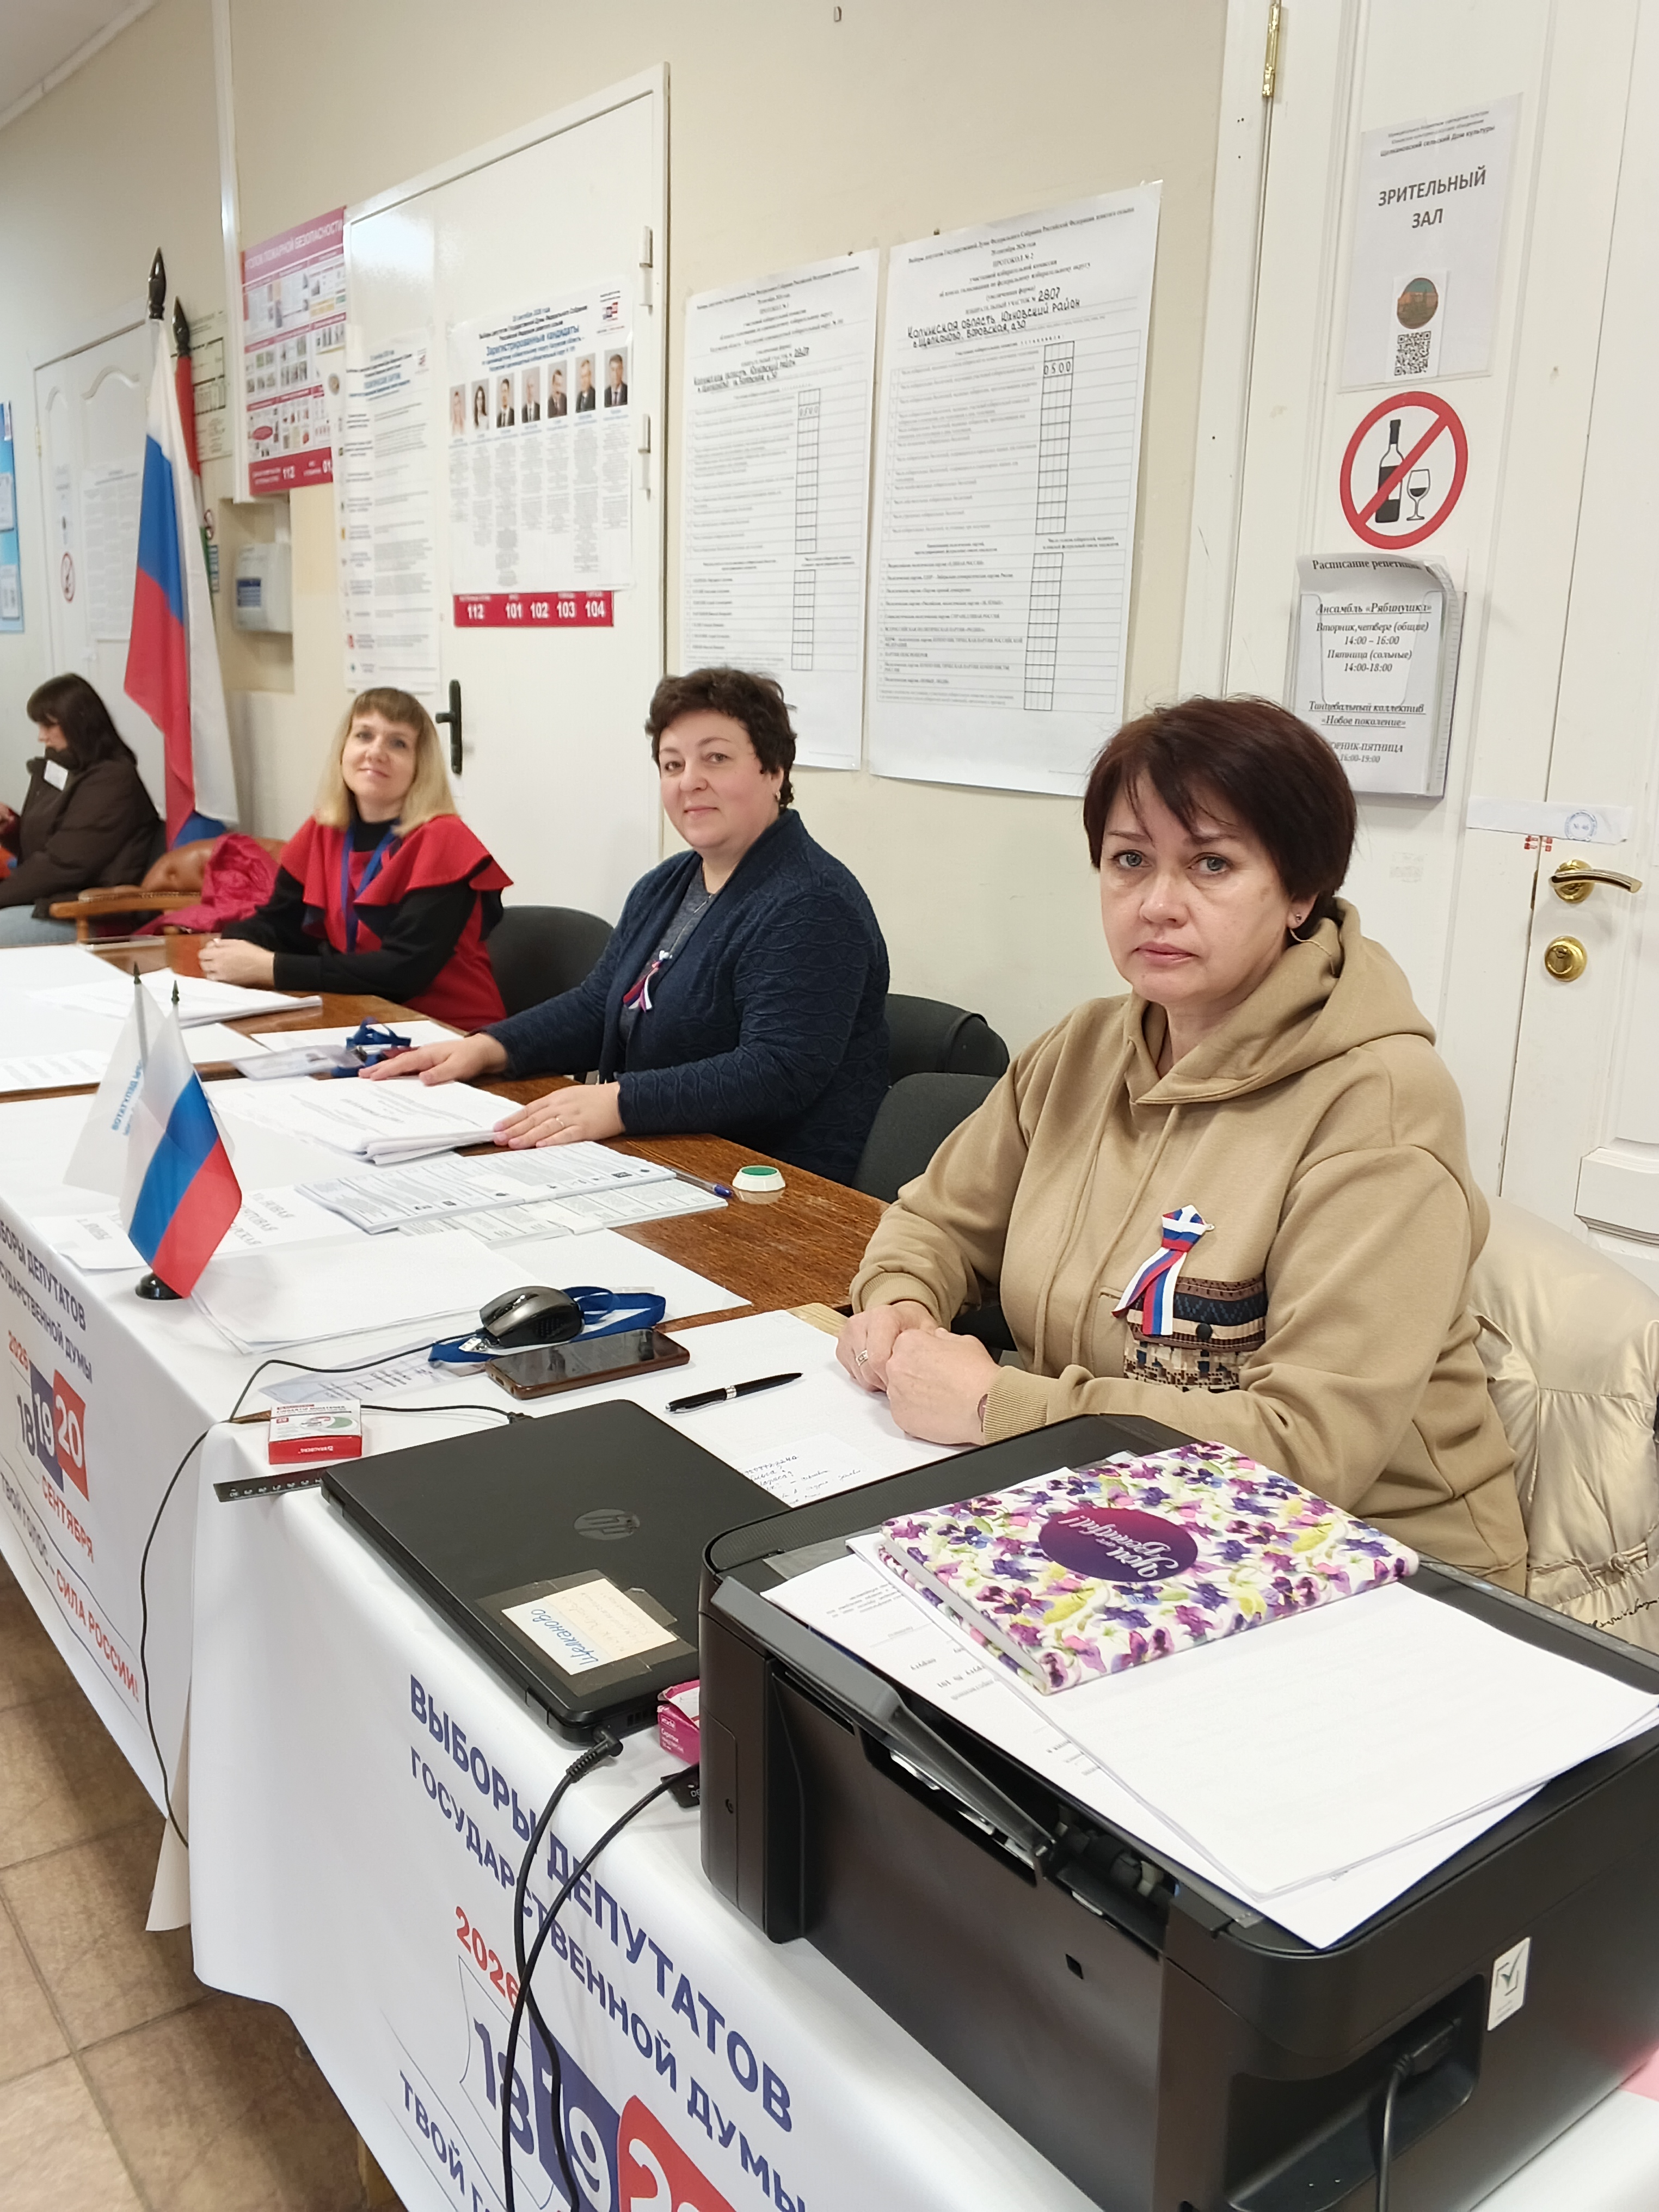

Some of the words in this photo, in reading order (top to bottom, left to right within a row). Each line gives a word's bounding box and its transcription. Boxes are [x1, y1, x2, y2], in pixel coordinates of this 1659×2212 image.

[1449, 131, 1465, 142] Дом
[1465, 125, 1496, 138] культуры
[1378, 165, 1487, 207] ЗРИТЕЛЬНЫЙ
[1412, 208, 1443, 229] ЗАЛ
[1038, 286, 1060, 303] 2807
[1312, 560, 1369, 570] Расписание
[467, 603, 485, 620] 112
[505, 603, 523, 619] 101
[530, 601, 549, 619] 102
[556, 601, 577, 618] 103
[585, 600, 606, 618] 104
[1316, 603, 1363, 615] Ансамбль
[1327, 648, 1368, 659] Пятница
[1369, 649, 1413, 661] (сольные)
[1344, 635, 1367, 645] 14:00
[1376, 635, 1400, 645] 16:00
[1344, 662, 1393, 673] 14:00-18:00
[1322, 715, 1353, 726] «Новое
[1354, 717, 1406, 727] поколение»
[27, 1249, 86, 1331] ДЕПУТАТОВ
[65, 1335, 93, 1385] ДУМЫ
[17, 1393, 36, 1457] 18
[35, 1392, 55, 1458] 19
[55, 1394, 84, 1469] 20
[41, 1474, 95, 1564] СЕНТЯБРЯ
[1106, 1546, 1179, 1578] You
[56, 1568, 86, 1627] СИЛА
[88, 1610, 140, 1704] РОССИИ!
[530, 1608, 599, 1666] Щелканово
[410, 1673, 538, 1855] ВЫБОРЫ
[547, 1832, 793, 2133] ДЕПУТАТОВ
[410, 1746, 678, 2093] ГОСУДАРСТВЕННОЙ
[687, 2075, 806, 2212] ДУМЫ
[456, 1905, 521, 2011] 2026
[473, 2016, 534, 2155] 18
[400, 2069, 465, 2197] ТВОЙ
